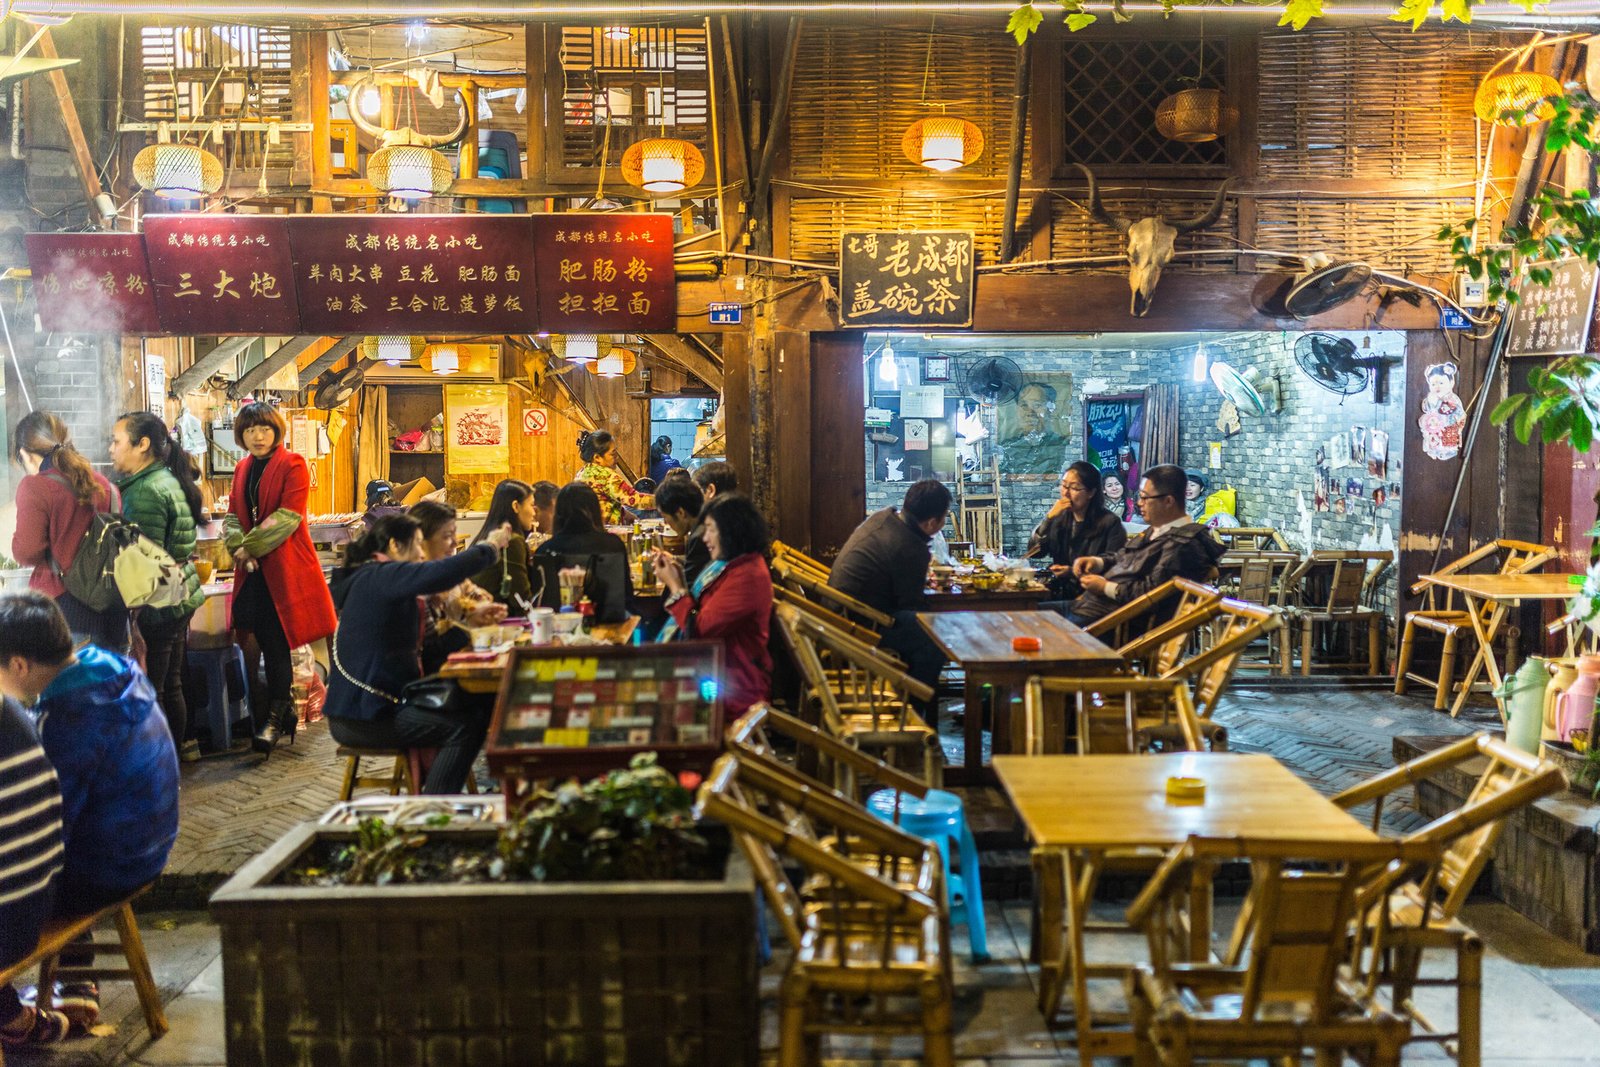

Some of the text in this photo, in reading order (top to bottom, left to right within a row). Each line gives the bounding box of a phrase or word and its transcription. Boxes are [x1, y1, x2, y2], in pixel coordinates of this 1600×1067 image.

[168, 233, 270, 247] 成都传统名小吃
[345, 234, 483, 251] 成都传统名小吃
[555, 231, 654, 244] 成都传统名小吃
[558, 257, 653, 283] 肥肠粉
[848, 234, 969, 283] 七哥 老成都
[41, 271, 148, 295] 伤心凉粉
[174, 269, 281, 299] 三大炮
[308, 264, 521, 284] 羊肉大串 豆花 肥肠面
[326, 293, 524, 314] 油茶 三合泥 菠萝饭
[558, 291, 651, 316] 担担面
[848, 277, 960, 318] 盖碗茶
